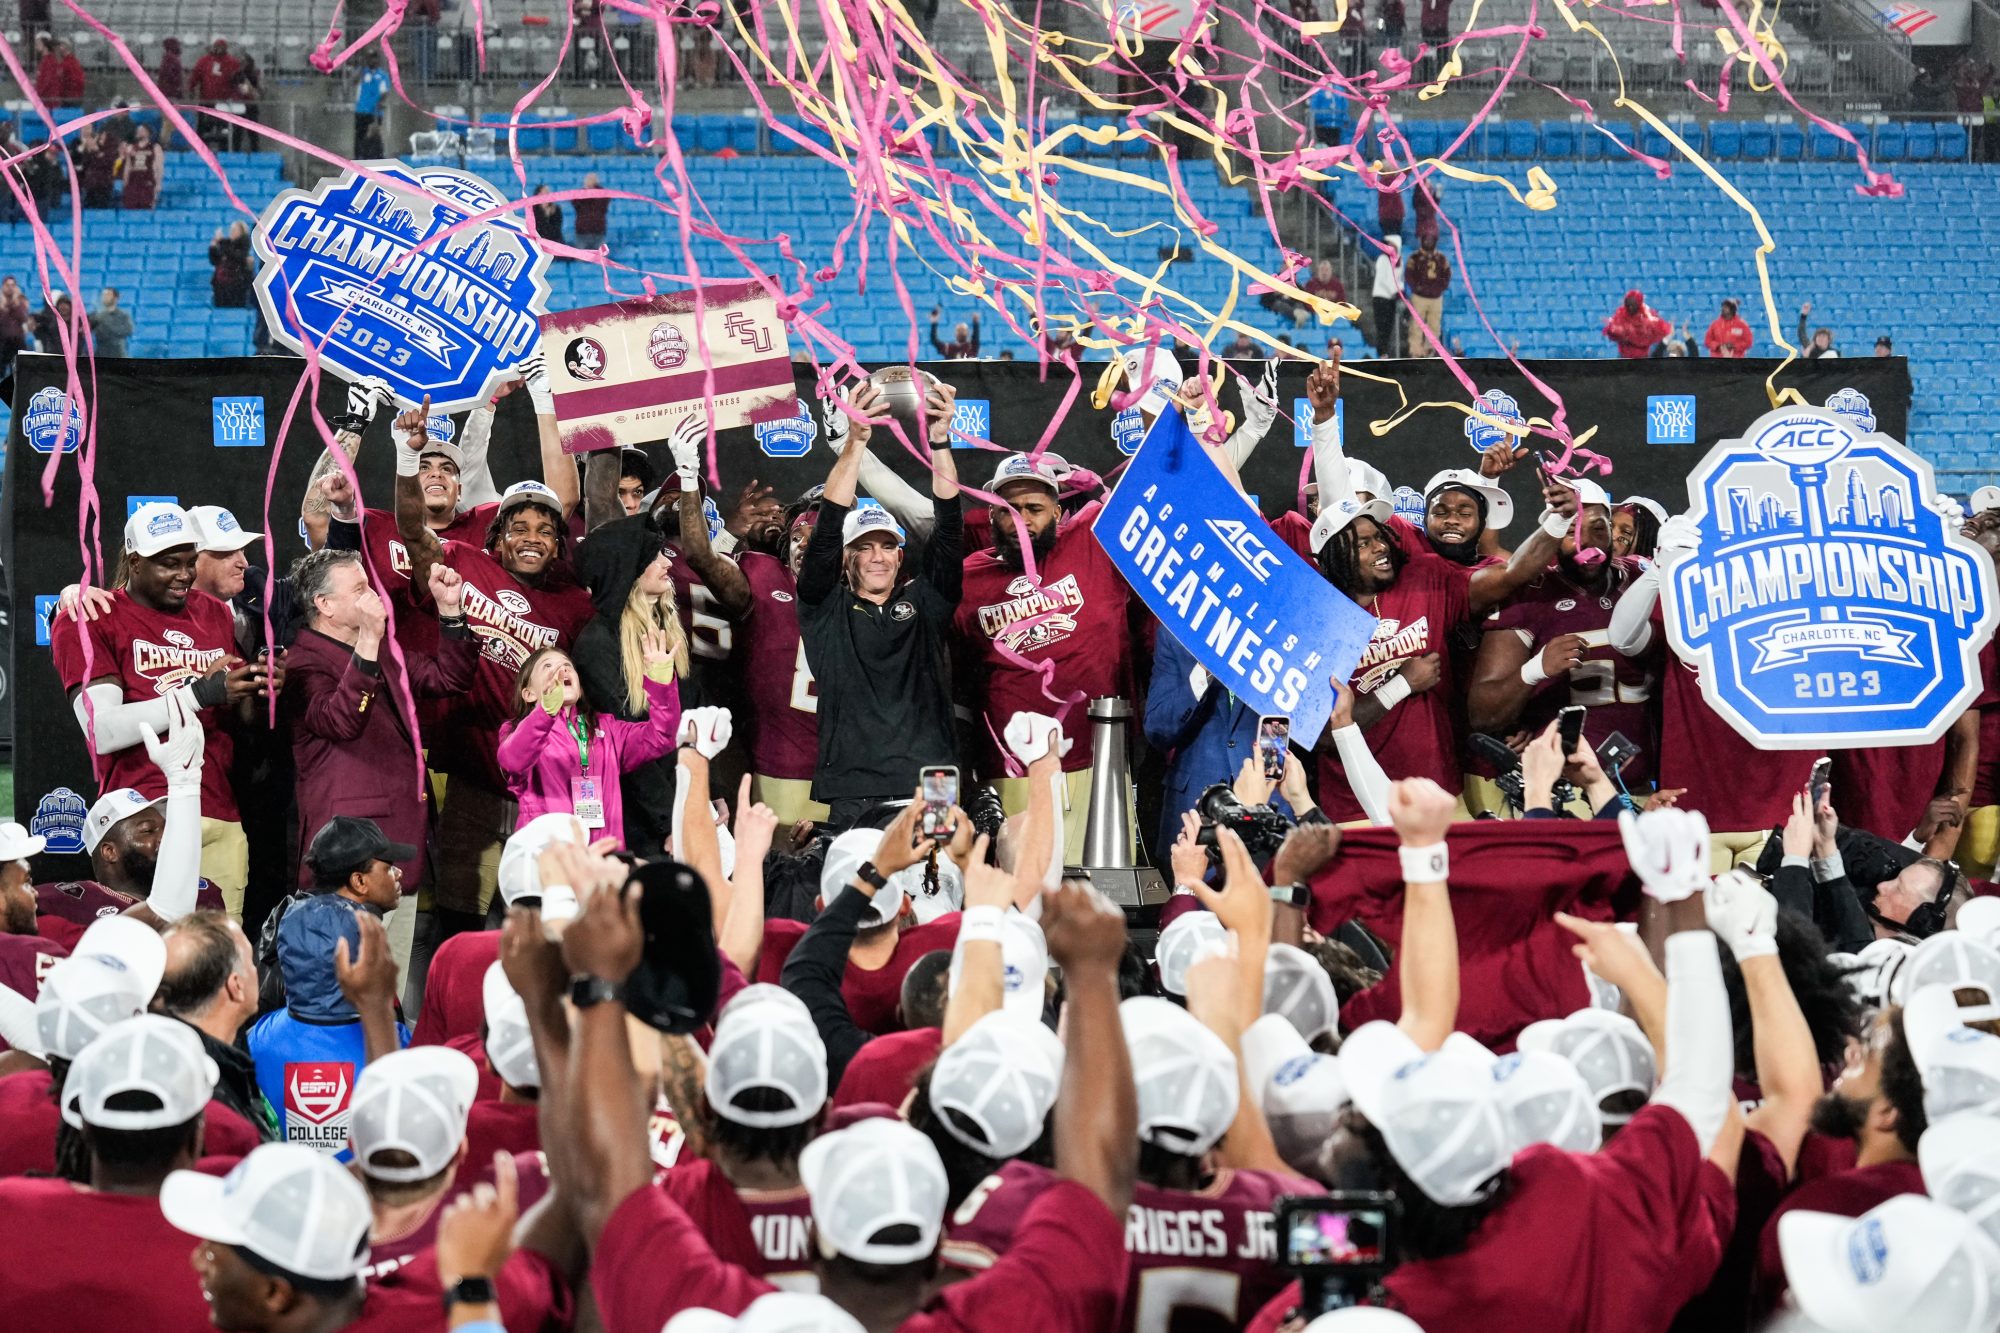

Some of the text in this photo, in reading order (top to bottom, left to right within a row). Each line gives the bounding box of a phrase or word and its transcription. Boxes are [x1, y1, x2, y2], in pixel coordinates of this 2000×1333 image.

[432, 183, 496, 211] ACC
[274, 205, 537, 363] CHAMPIONSHIP
[348, 290, 434, 338] CHARLOTTE, NC
[334, 318, 413, 367] 2023
[724, 311, 773, 353] FSU
[222, 402, 257, 416] NEW
[635, 397, 741, 421] ACCOMPLISH GRTNESS
[1656, 401, 1689, 414] NEW
[25, 413, 83, 434] CHAMPIONHIP
[216, 414, 262, 428] YORK
[1649, 412, 1693, 426] YORK
[223, 427, 257, 440] LIFE
[1656, 425, 1689, 438] LIFE
[1773, 429, 1836, 448] ACC
[1209, 518, 1284, 580] ACC
[1143, 483, 1322, 670] ACCOMPLISH
[1680, 542, 1977, 639] CHAMPIONSHIP
[501, 596, 527, 609] ACC
[1119, 505, 1308, 713] GREATNESS
[1556, 600, 1573, 609] ACC
[461, 584, 558, 650] CHAMPIONS
[1357, 619, 1428, 668] AMPIONS
[1782, 628, 1882, 644] CHARLOTTE, NC
[1793, 670, 1882, 698] 2023
[32, 812, 85, 834] CHAMPIONSH
[100, 906, 117, 915] ACC
[300, 1081, 337, 1094] ESPN
[288, 1126, 348, 1141] COLLEGE
[1237, 1210, 1279, 1263] JR
